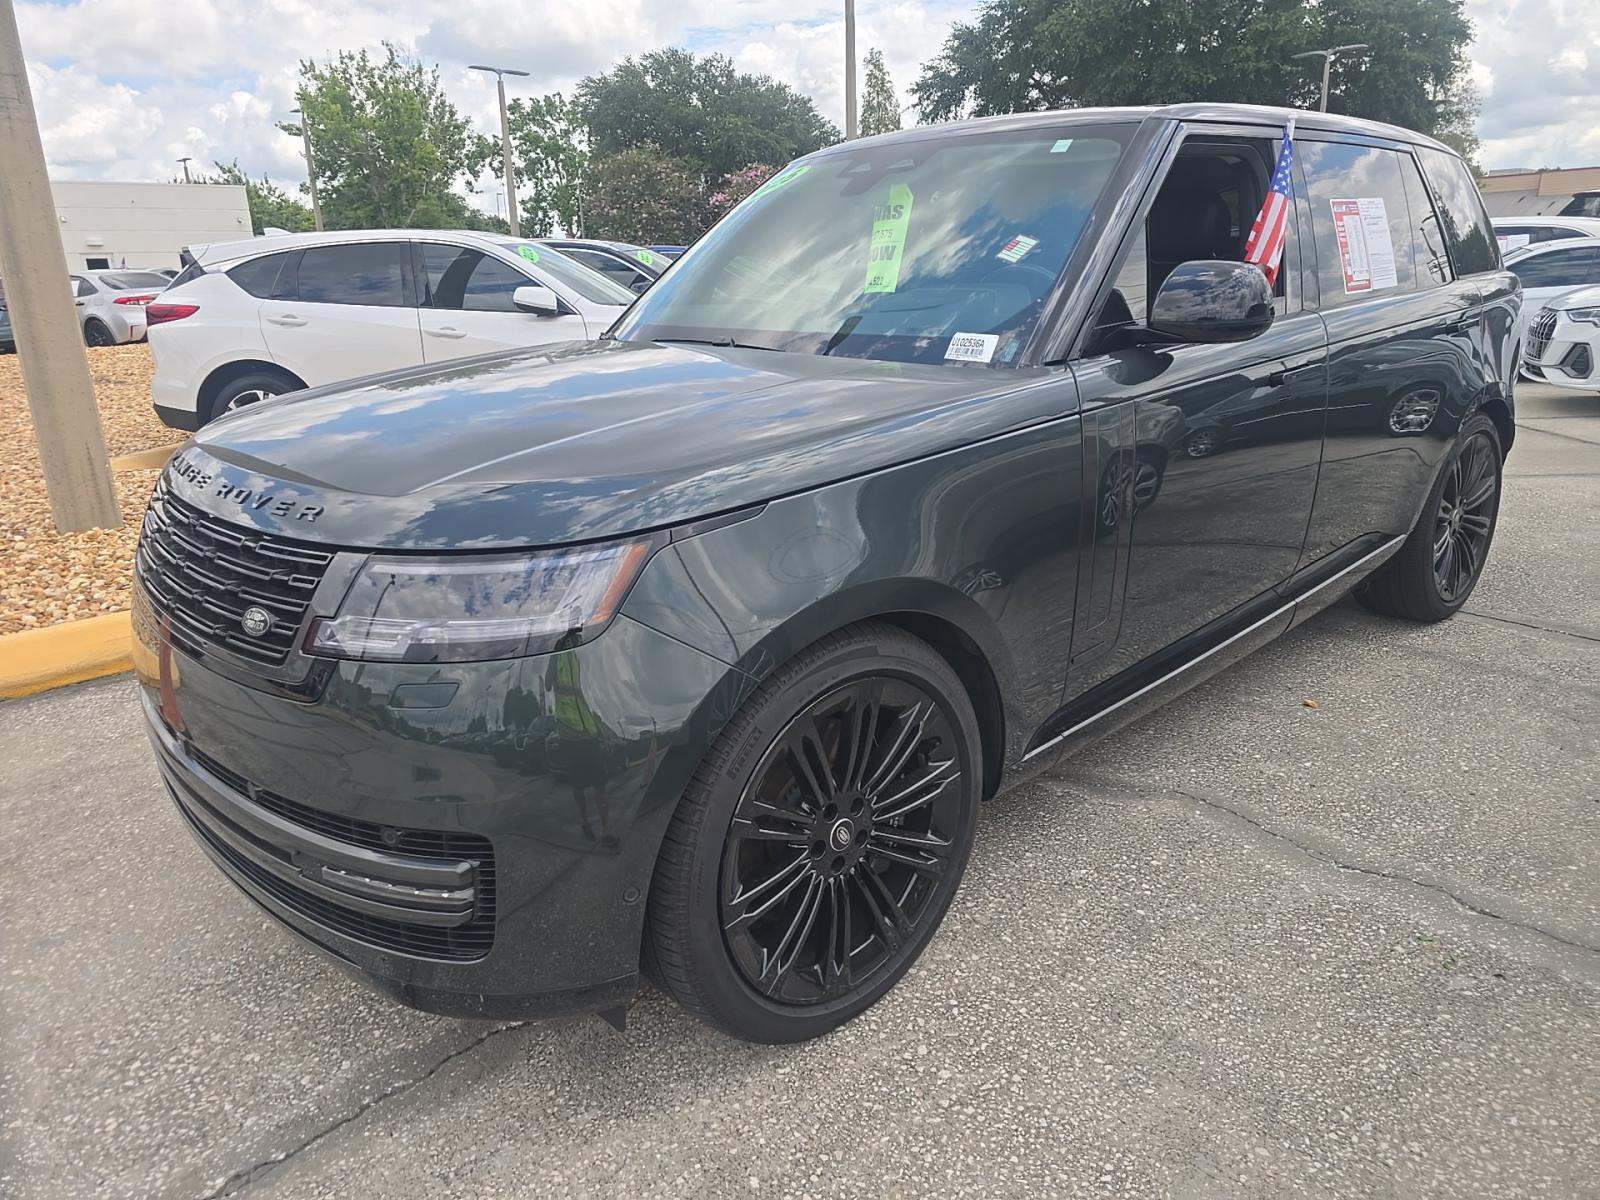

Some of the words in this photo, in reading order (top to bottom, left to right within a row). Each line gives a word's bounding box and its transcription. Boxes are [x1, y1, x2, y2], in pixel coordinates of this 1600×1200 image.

[871, 245, 897, 262] OW
[171, 451, 213, 489] ANGE
[215, 484, 325, 523] ROVER
